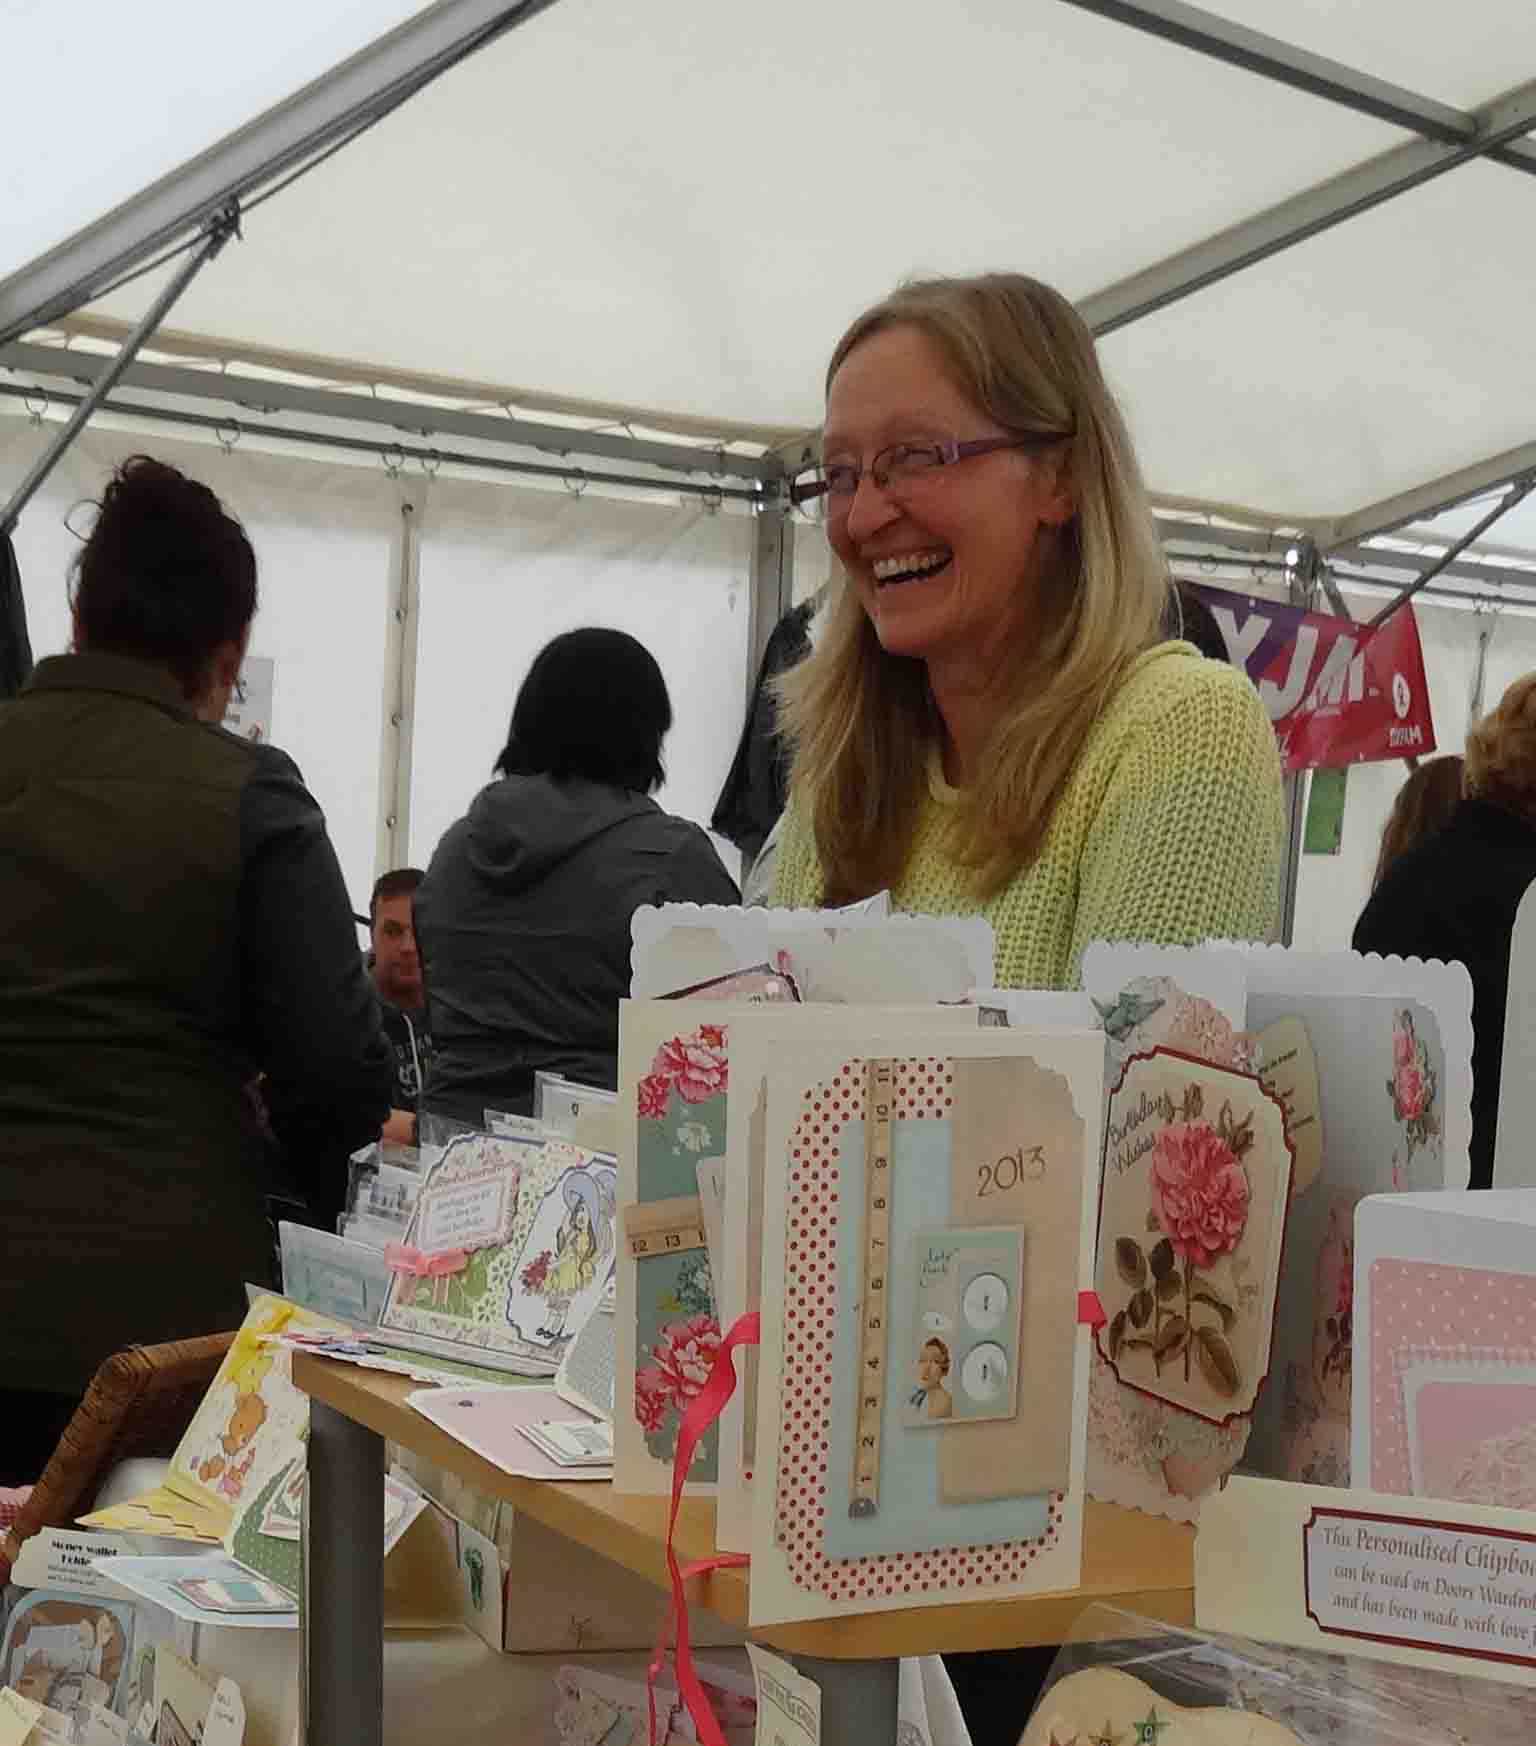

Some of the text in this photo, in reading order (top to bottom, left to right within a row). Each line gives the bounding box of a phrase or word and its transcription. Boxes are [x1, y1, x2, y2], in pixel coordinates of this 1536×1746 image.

[976, 1146, 1046, 1198] 2013
[1322, 1526, 1353, 1546] This
[1356, 1526, 1463, 1565] Personalised
